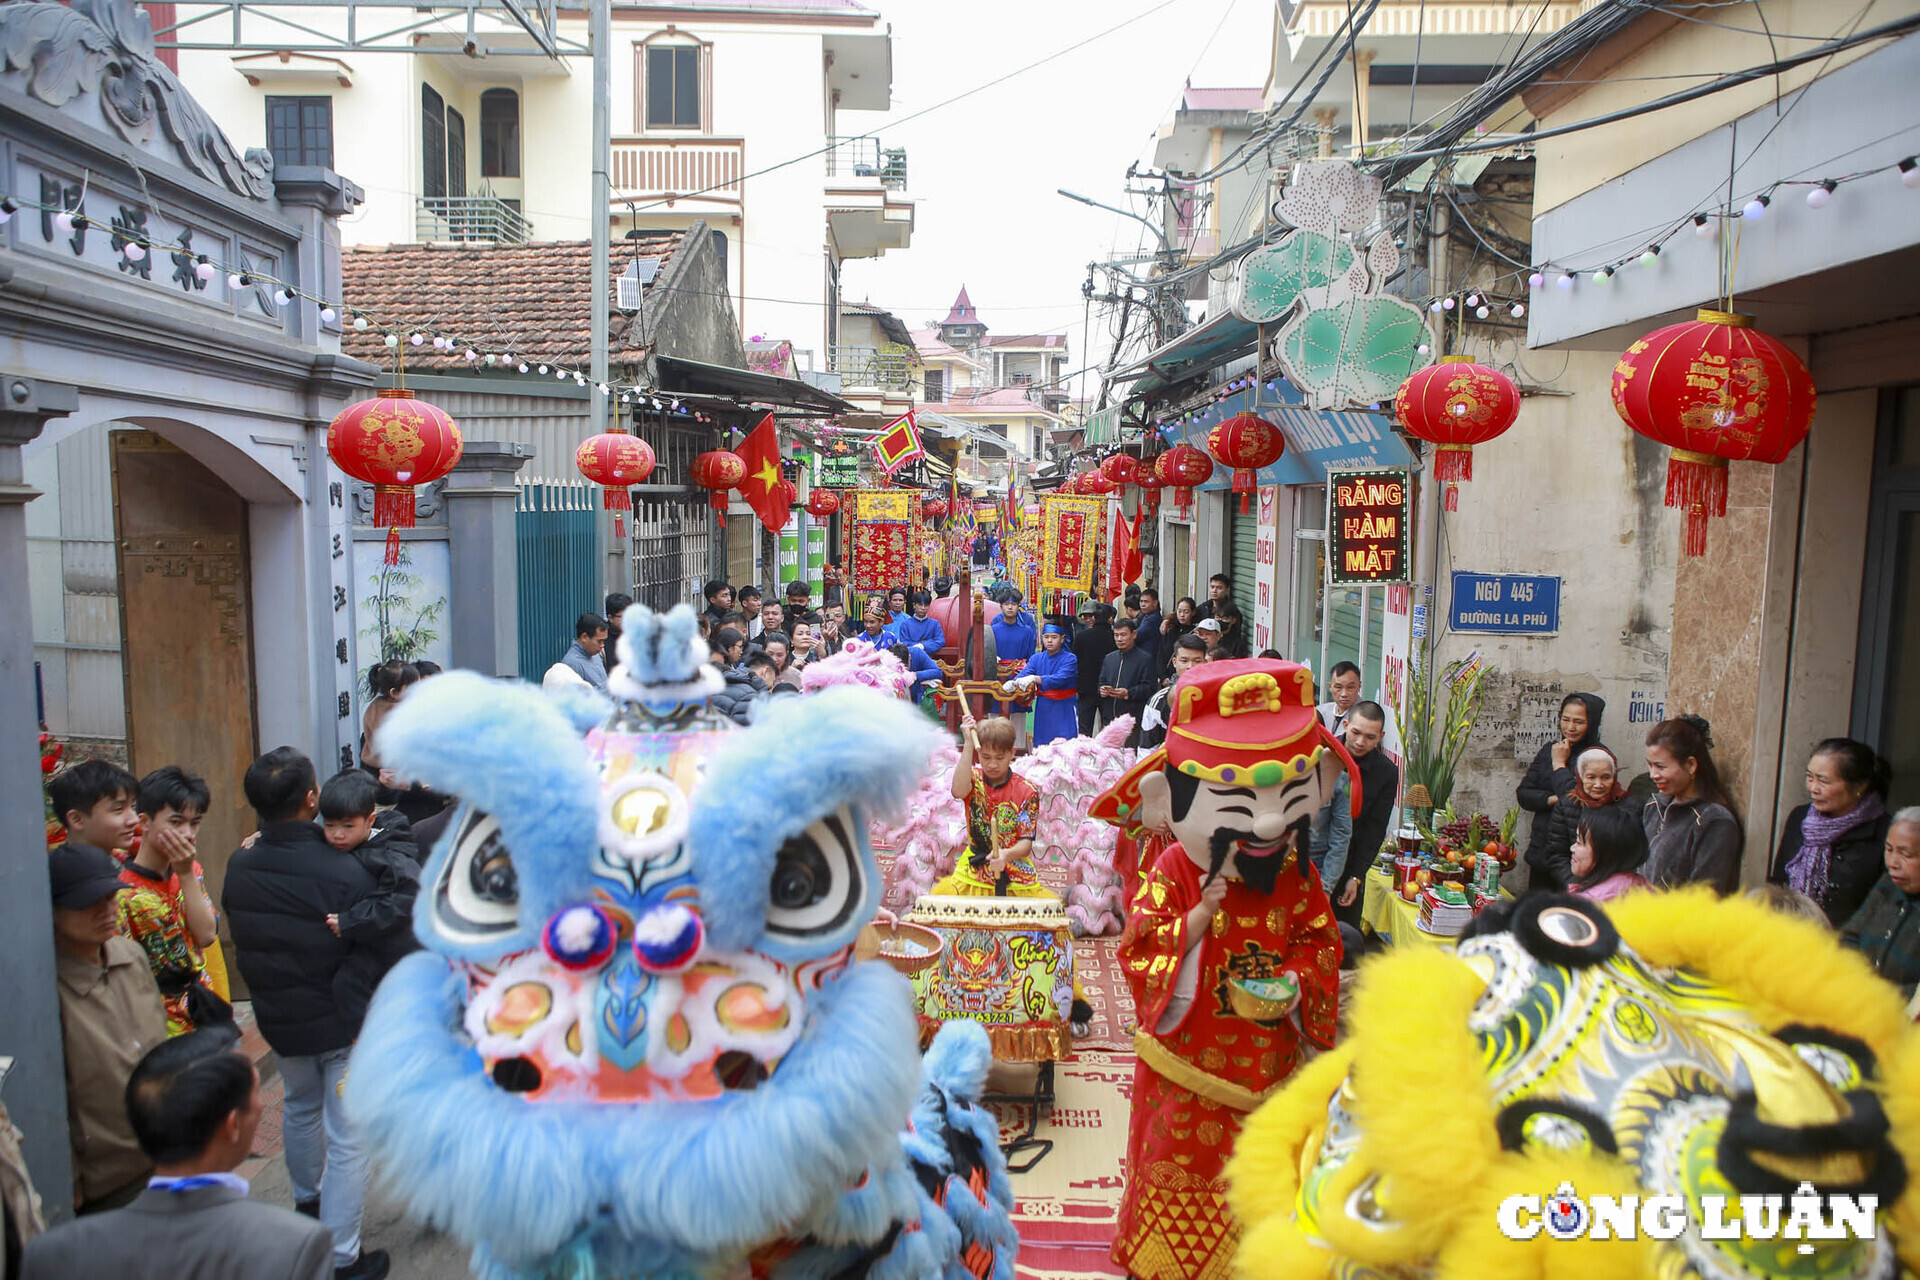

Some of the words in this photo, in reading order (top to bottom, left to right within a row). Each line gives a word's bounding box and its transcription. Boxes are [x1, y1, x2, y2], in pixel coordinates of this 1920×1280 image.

[1338, 479, 1402, 507] RĂNG
[1344, 512, 1396, 540] HÀM
[1345, 544, 1396, 578] MẶT
[1475, 578, 1501, 602] NGÕ
[1510, 581, 1534, 602] 445
[1459, 610, 1501, 625] ĐƯỜNG
[1504, 613, 1520, 625] LA
[1008, 935, 1059, 975] Thắng
